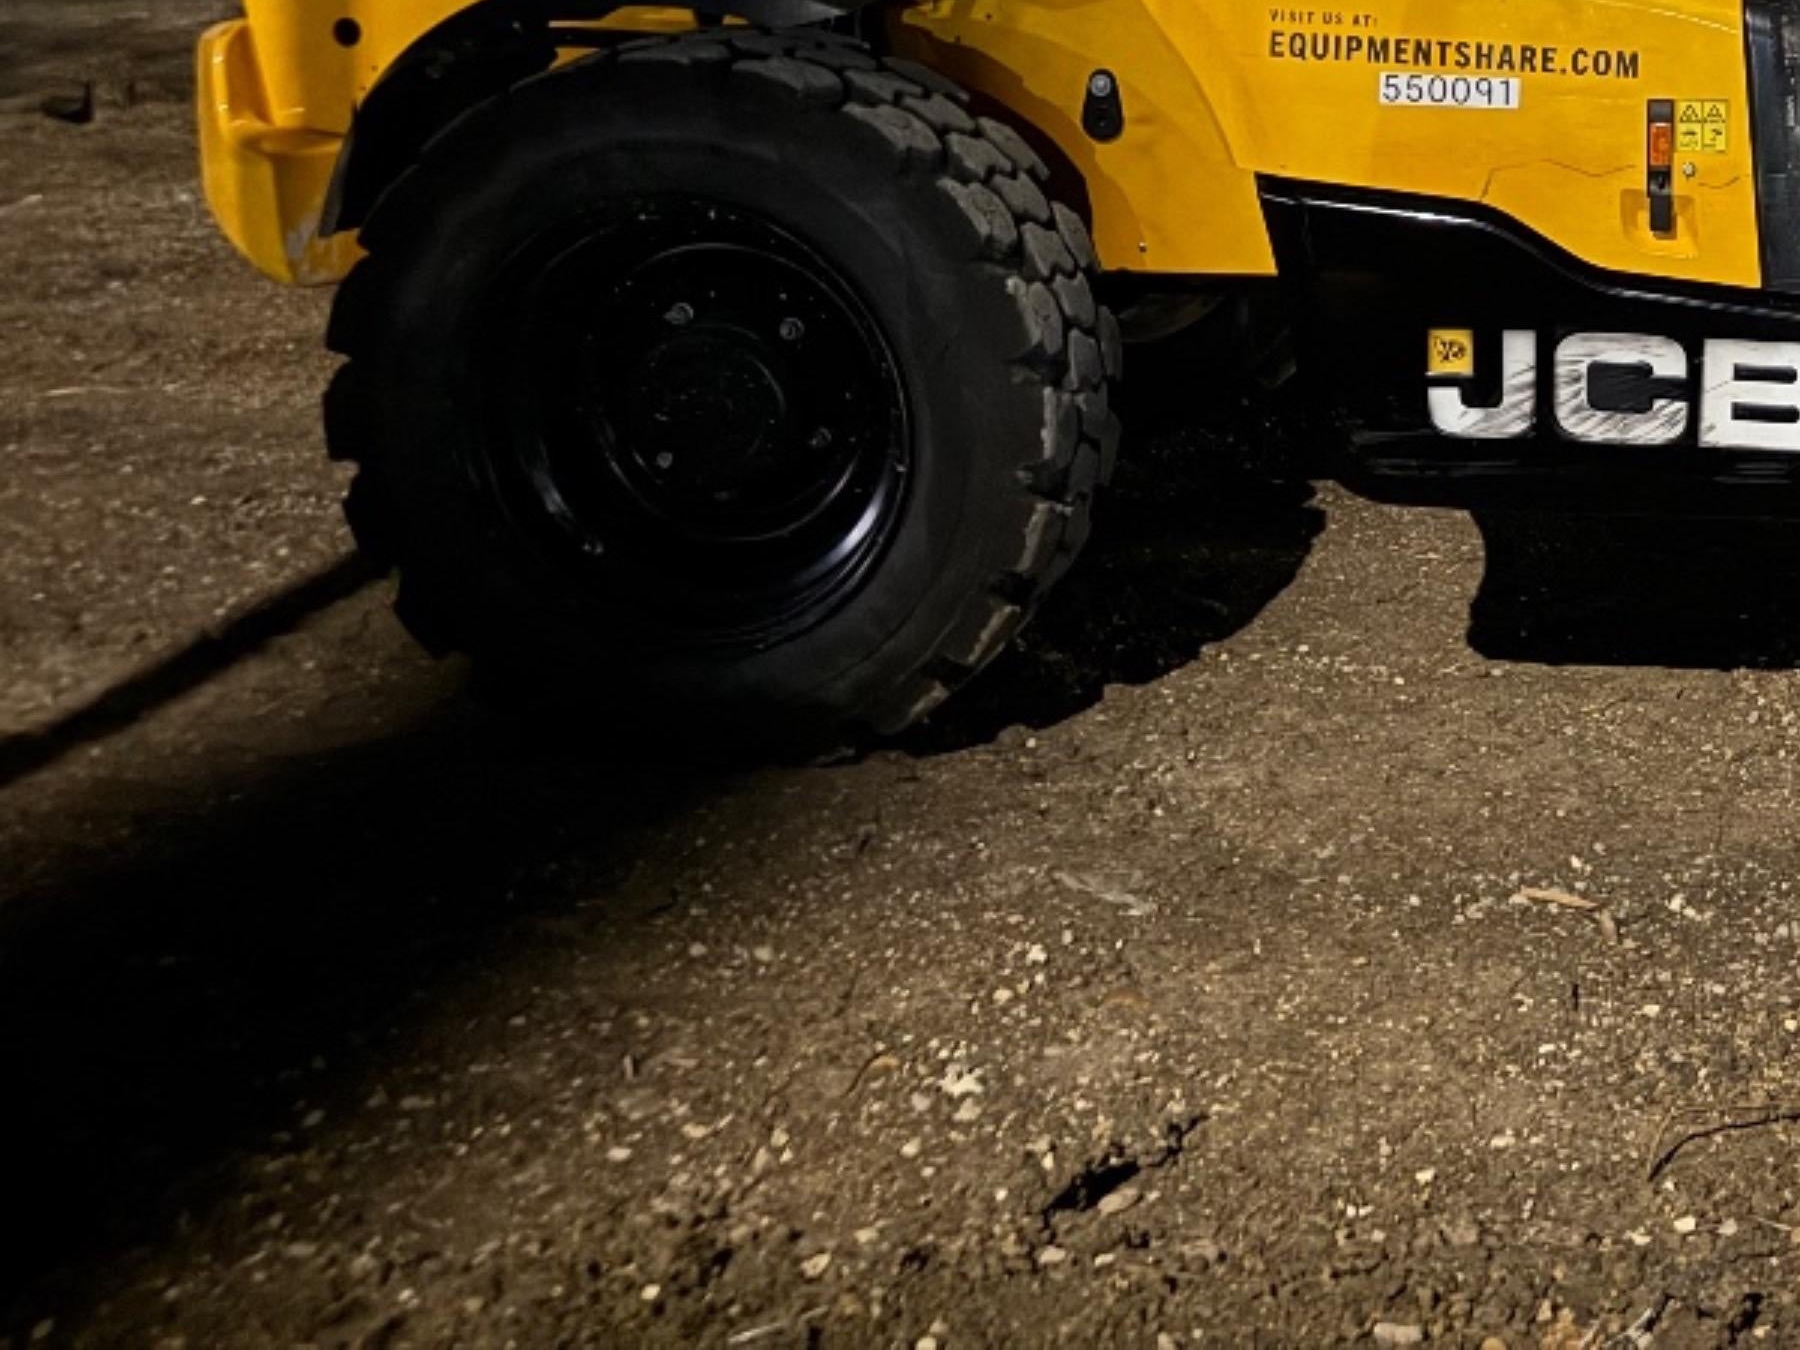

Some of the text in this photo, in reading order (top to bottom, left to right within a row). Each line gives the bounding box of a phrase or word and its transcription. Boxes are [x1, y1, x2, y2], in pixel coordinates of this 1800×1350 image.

[1269, 8, 1379, 28] VISIT US AT:
[1270, 30, 1639, 79] EQUIPMENTSHARE.COM
[1383, 74, 1511, 106] 550091
